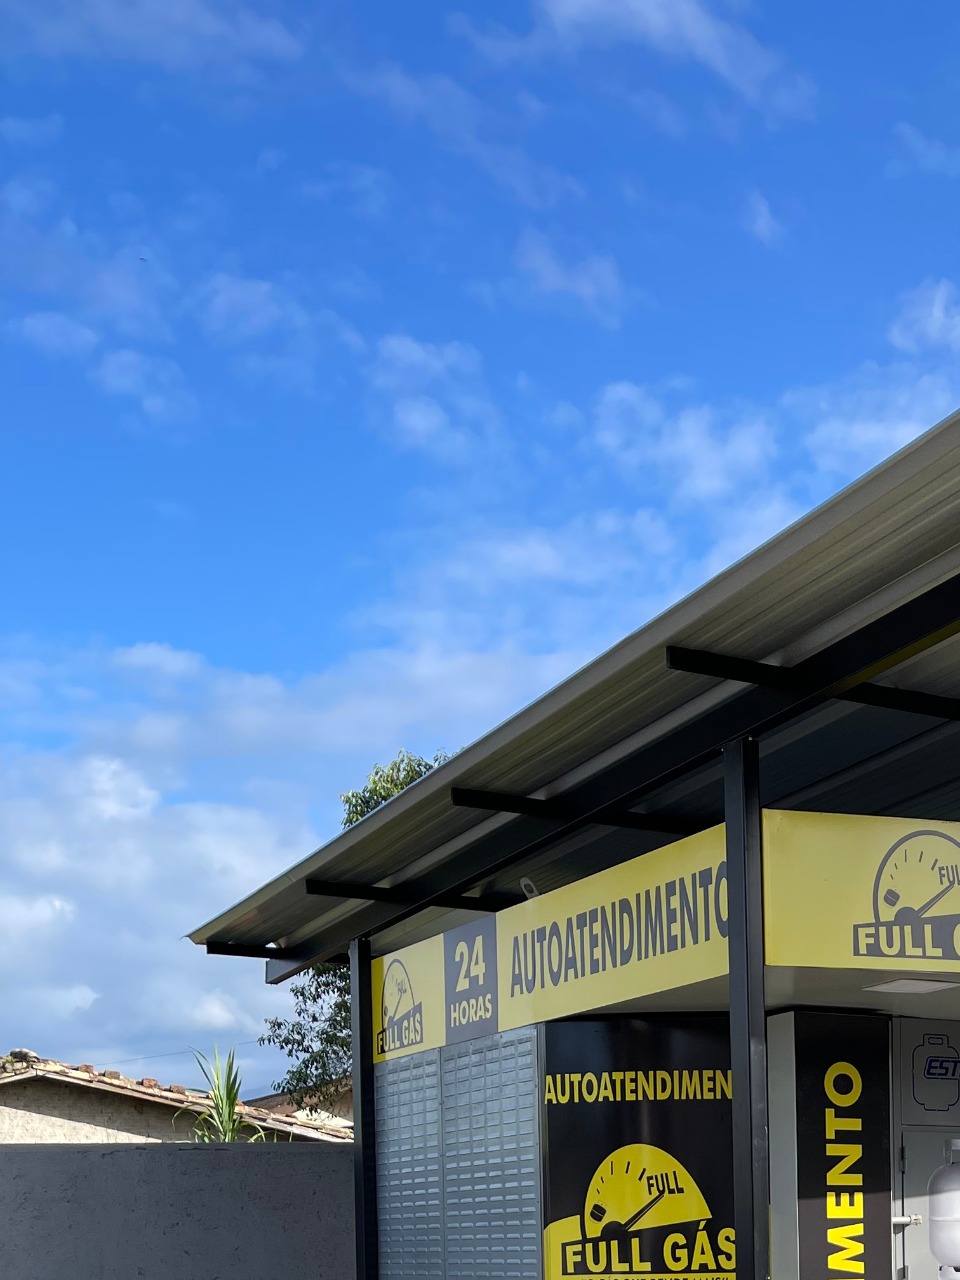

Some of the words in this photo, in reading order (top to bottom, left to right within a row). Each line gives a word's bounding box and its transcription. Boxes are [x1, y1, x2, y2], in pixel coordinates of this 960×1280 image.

[510, 860, 729, 998] AUTOATENDIMENTO
[857, 924, 942, 957] FULL
[455, 934, 486, 992] 24
[450, 993, 492, 1027] HORAS
[378, 1025, 401, 1053] FULL
[402, 1010, 421, 1046] GÁS
[544, 1069, 733, 1104] AUTOATENDIMEN
[646, 1171, 684, 1195] FULL
[566, 1237, 652, 1273] FULL
[663, 1220, 737, 1271] GÁS
